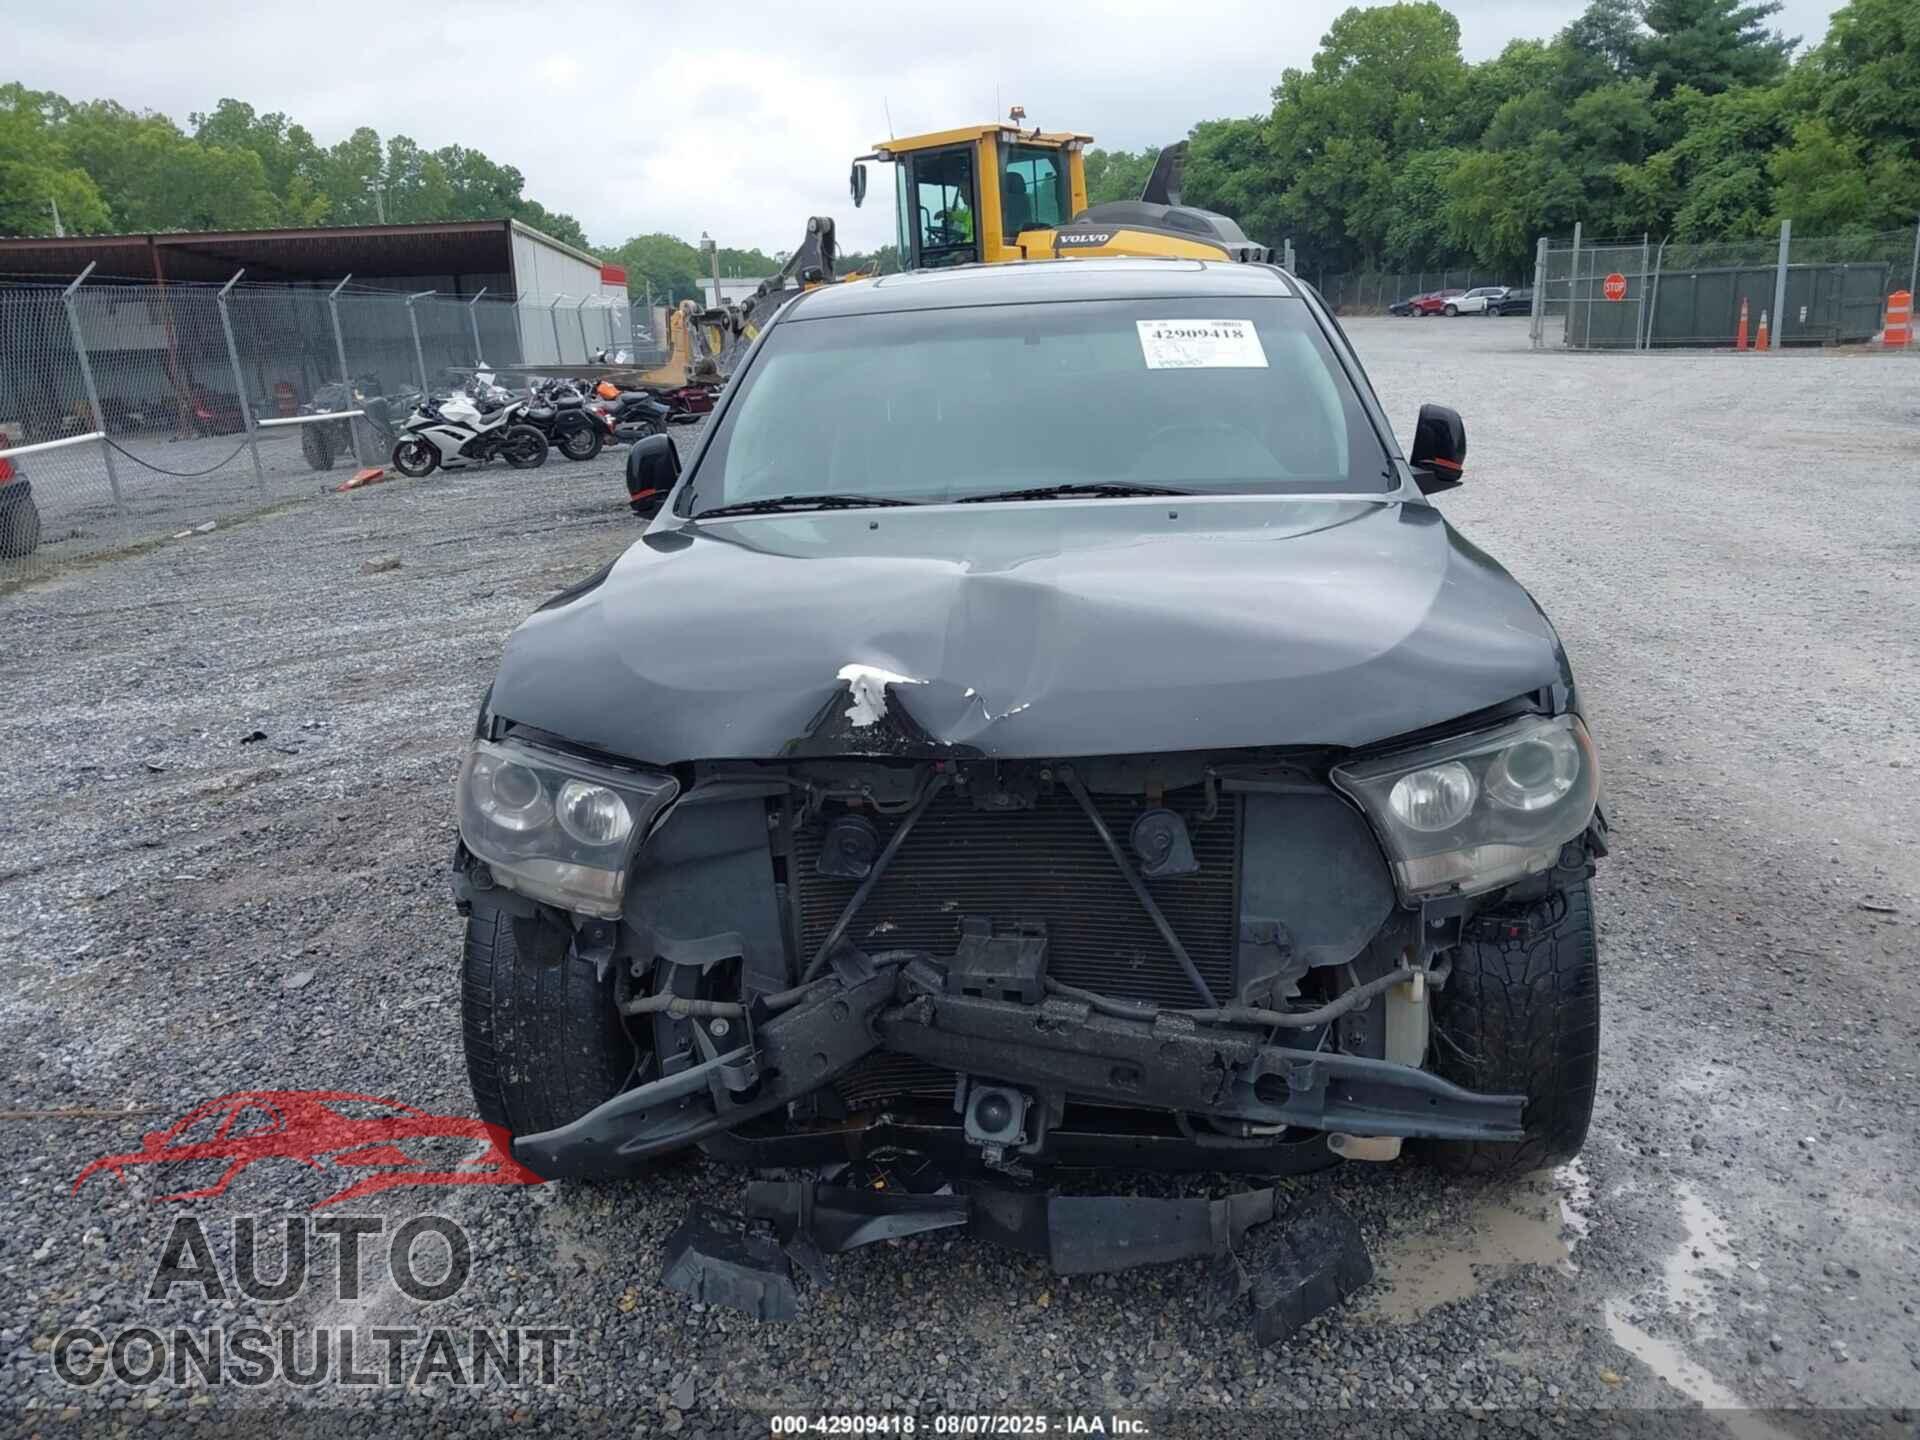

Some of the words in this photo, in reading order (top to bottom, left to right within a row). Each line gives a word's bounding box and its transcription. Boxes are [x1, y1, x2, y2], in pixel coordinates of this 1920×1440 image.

[1060, 233, 1109, 243] VOLVO
[1606, 282, 1625, 293] STOP
[1152, 328, 1244, 339] 42909418
